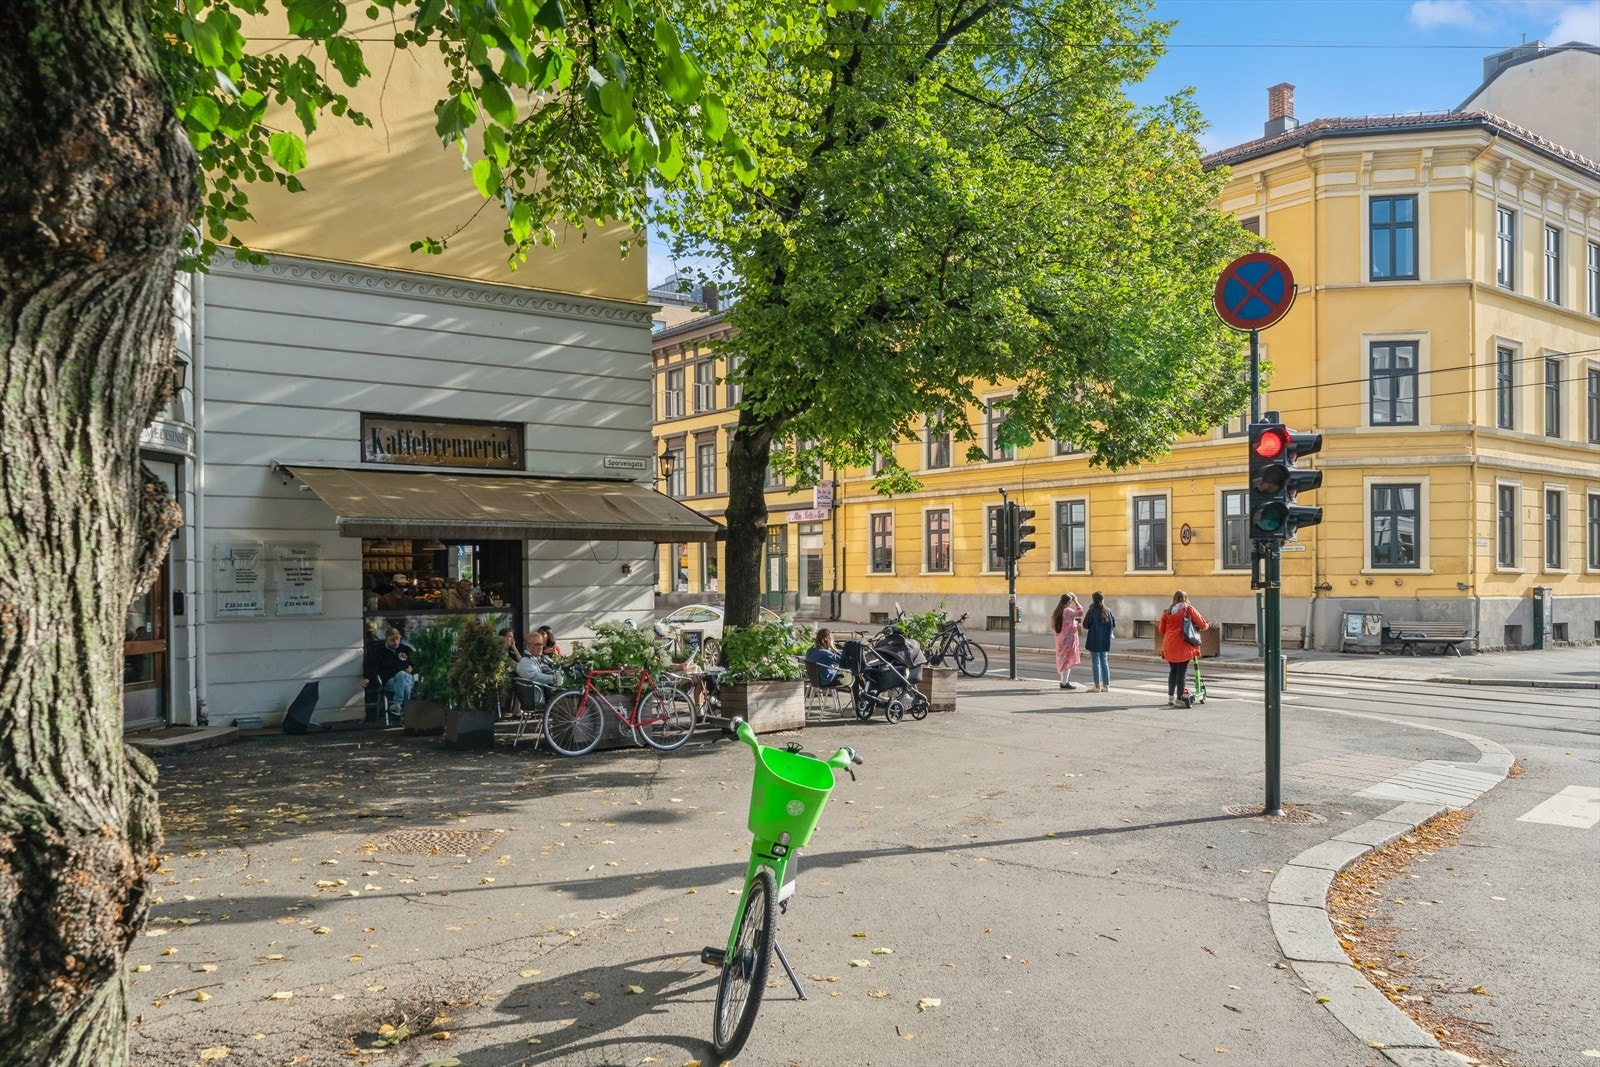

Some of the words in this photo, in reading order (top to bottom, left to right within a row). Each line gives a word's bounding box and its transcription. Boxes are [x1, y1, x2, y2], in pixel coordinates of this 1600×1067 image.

[371, 426, 514, 460] Kaffebrenneriet
[607, 459, 643, 468] Sporveisgata
[1182, 528, 1190, 540] 40
